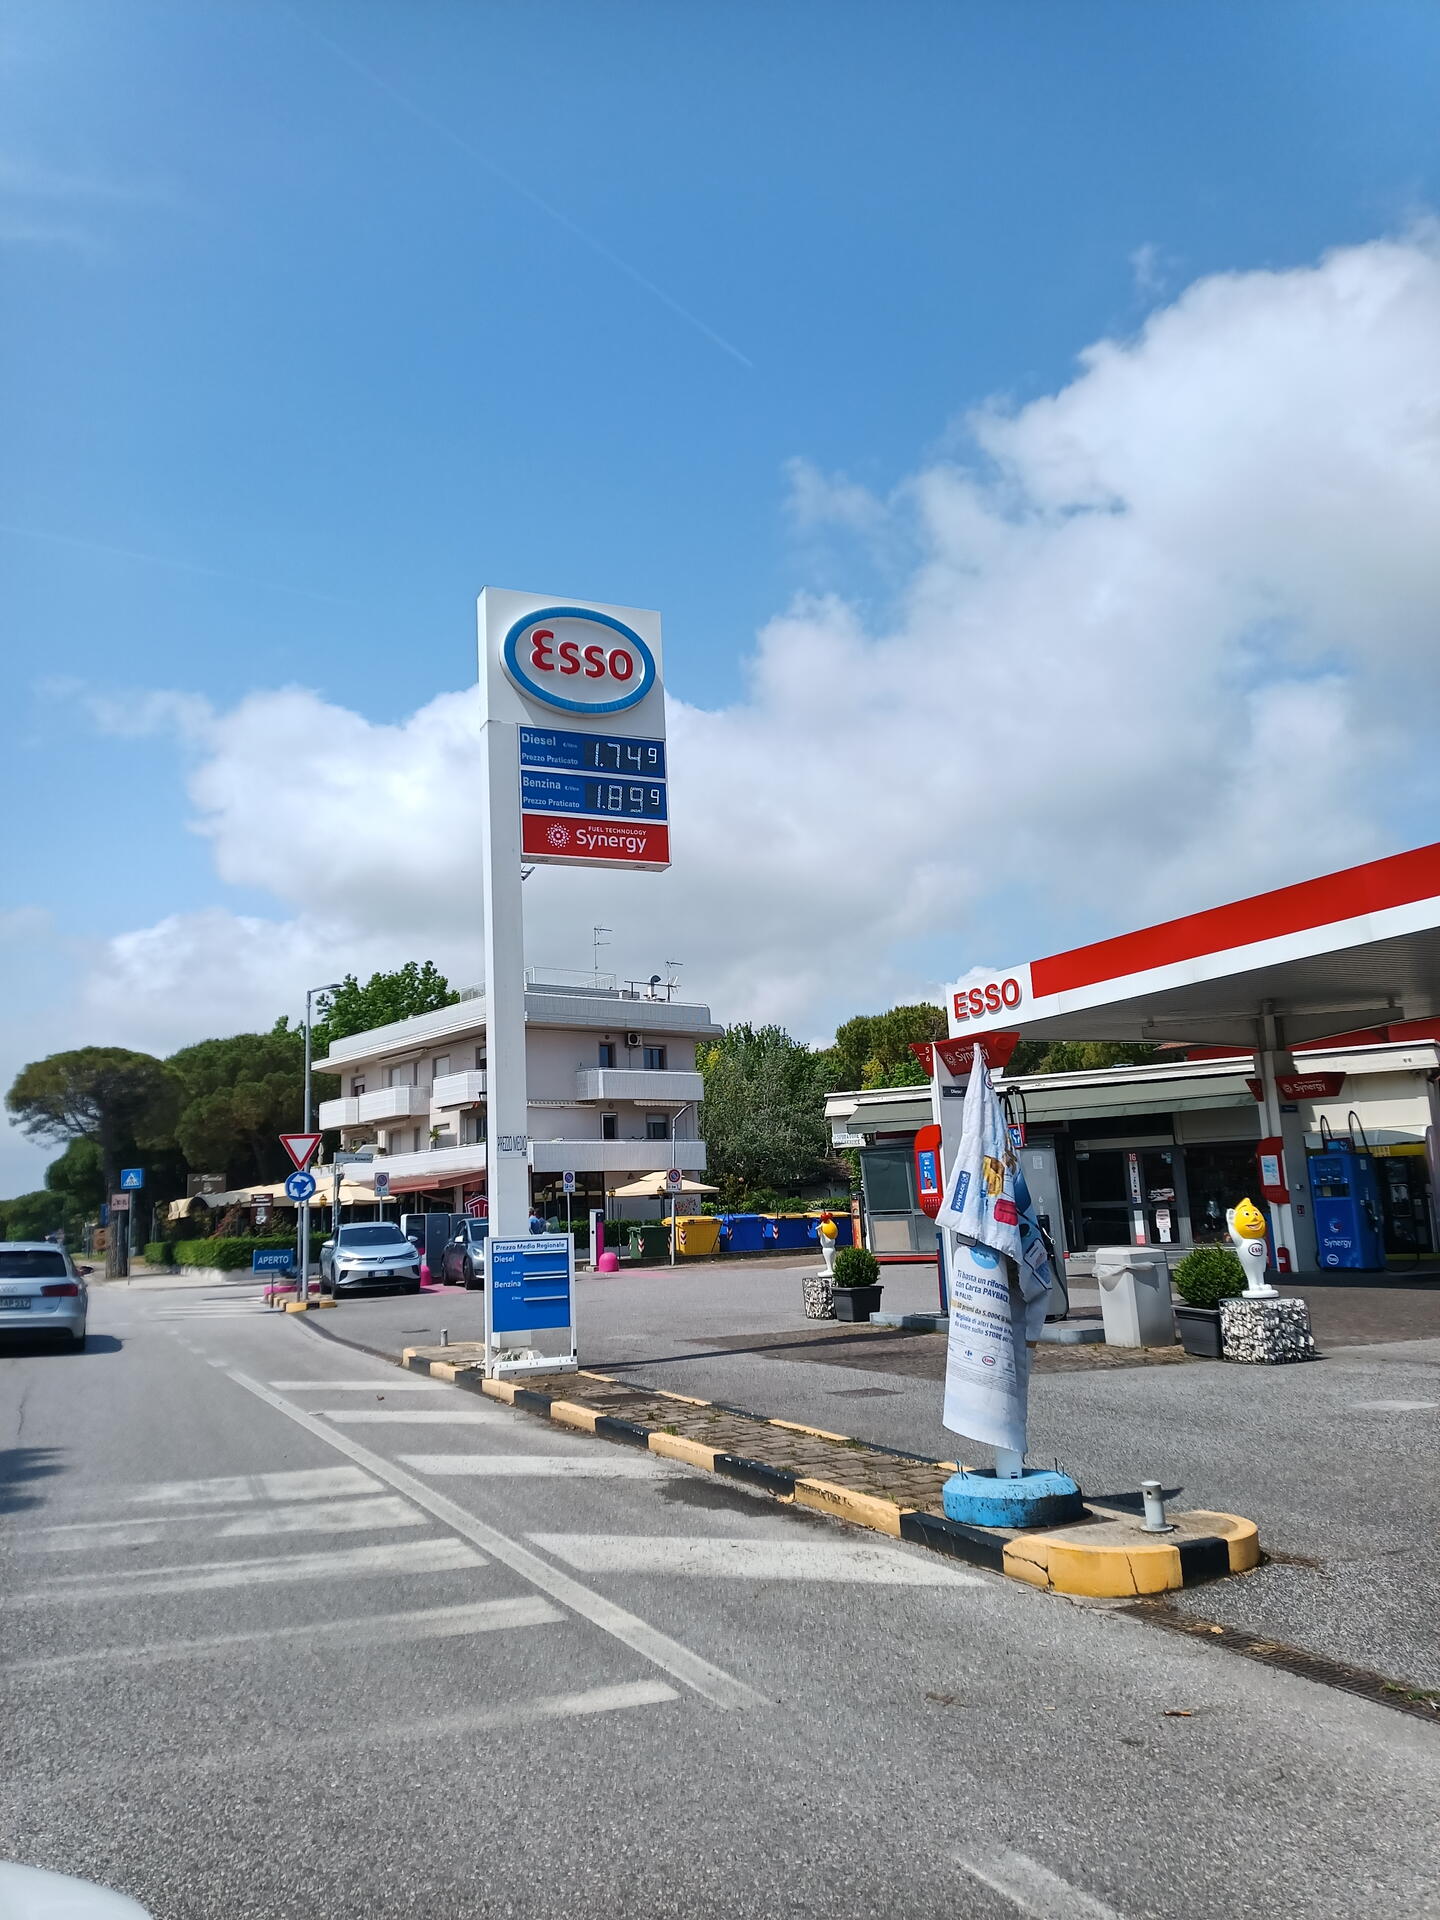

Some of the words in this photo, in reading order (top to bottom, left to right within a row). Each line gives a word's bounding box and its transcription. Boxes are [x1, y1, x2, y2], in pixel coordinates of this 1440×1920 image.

[521, 732, 556, 746] Diesel
[521, 752, 545, 762] Prezzo
[546, 755, 578, 765] Praticato
[595, 743, 657, 771] 1.749
[522, 776, 561, 790] Benzina
[523, 796, 546, 805] Prezzo
[548, 798, 580, 808] Praticato
[597, 785, 660, 813] 1.899
[605, 827, 647, 836] TECHNOLOGY
[576, 829, 647, 854] Synergy
[953, 978, 1021, 1019] ESSO
[1293, 1082, 1326, 1093] Synergy
[536, 1242, 565, 1250] Regionale
[1323, 1238, 1352, 1249] Synergy
[257, 1255, 289, 1265] APERTO
[493, 1254, 515, 1263] Diesel
[494, 1280, 522, 1289] Benzina
[955, 1280, 965, 1289] con
[965, 1282, 982, 1293] Carta
